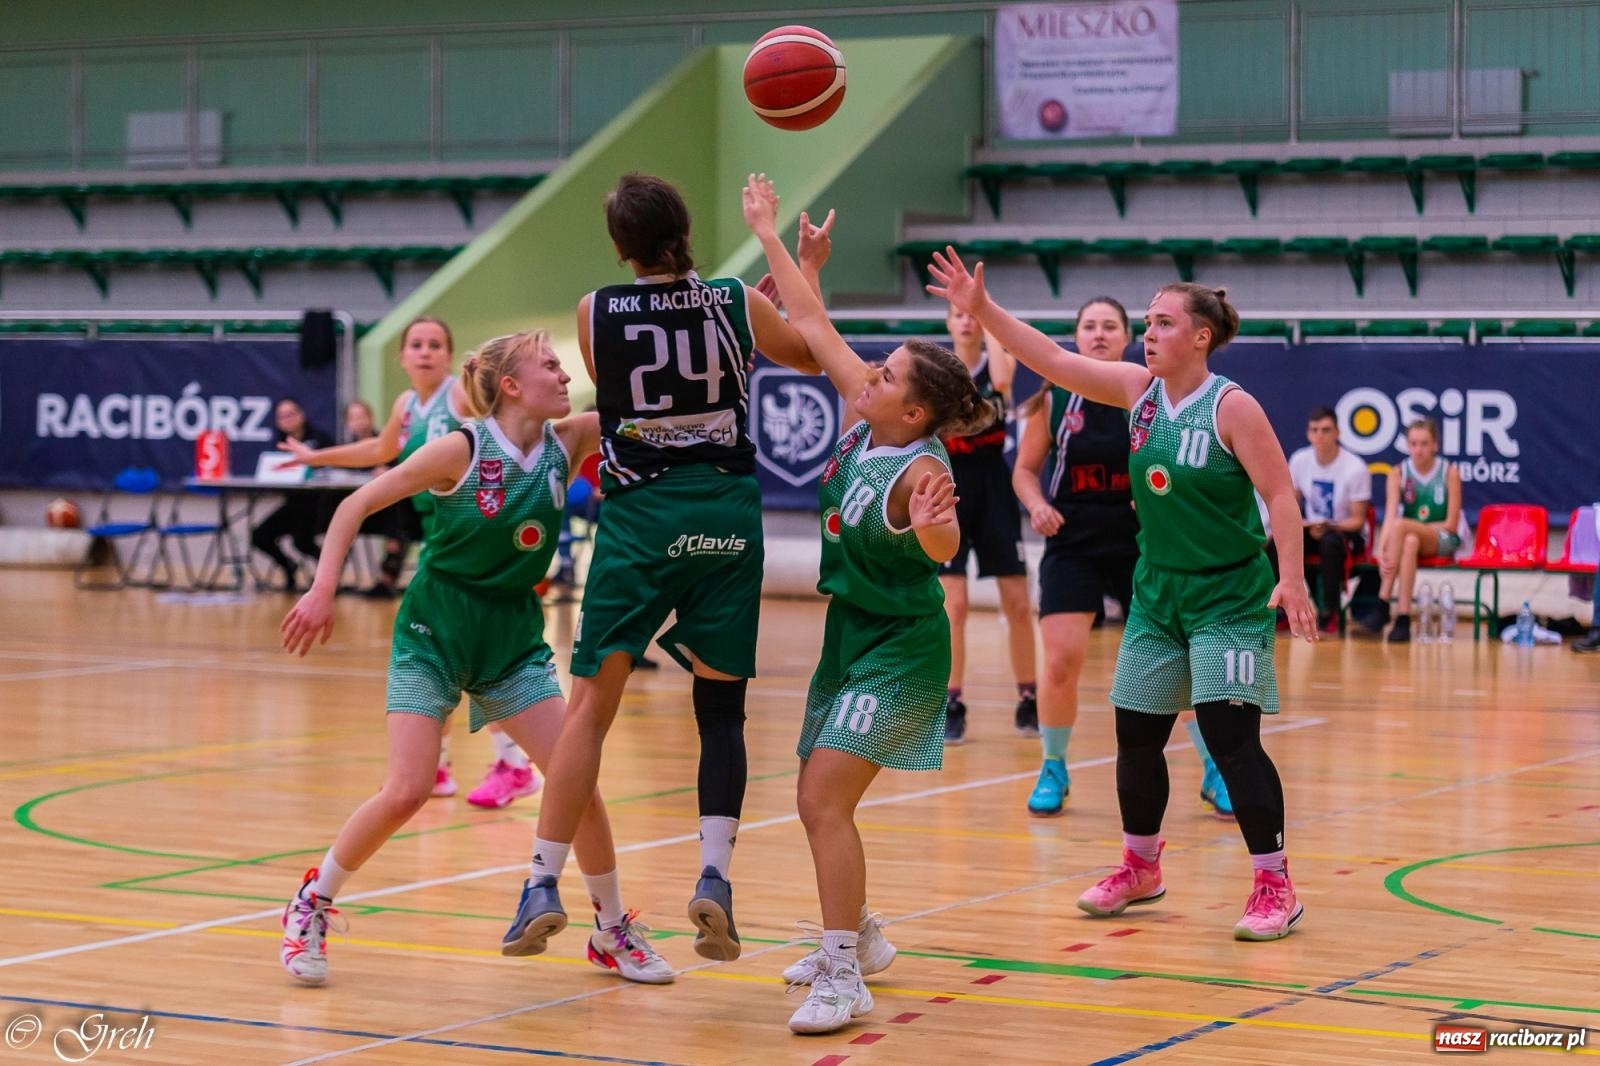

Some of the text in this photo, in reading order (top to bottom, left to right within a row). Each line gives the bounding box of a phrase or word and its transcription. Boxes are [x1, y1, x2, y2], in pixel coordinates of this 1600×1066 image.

[1017, 5, 1157, 38] MIESZKO
[608, 284, 733, 314] RKK RACIBÓRZ
[624, 318, 725, 412] 24
[36, 380, 273, 442] RACIBÓRZ
[198, 434, 220, 471] 5
[1176, 427, 1210, 468] 10
[1453, 457, 1520, 483] BÓRZ
[840, 475, 877, 528] 18
[686, 533, 747, 552] Clavis
[1224, 649, 1255, 686] 10
[832, 690, 879, 735] 18
